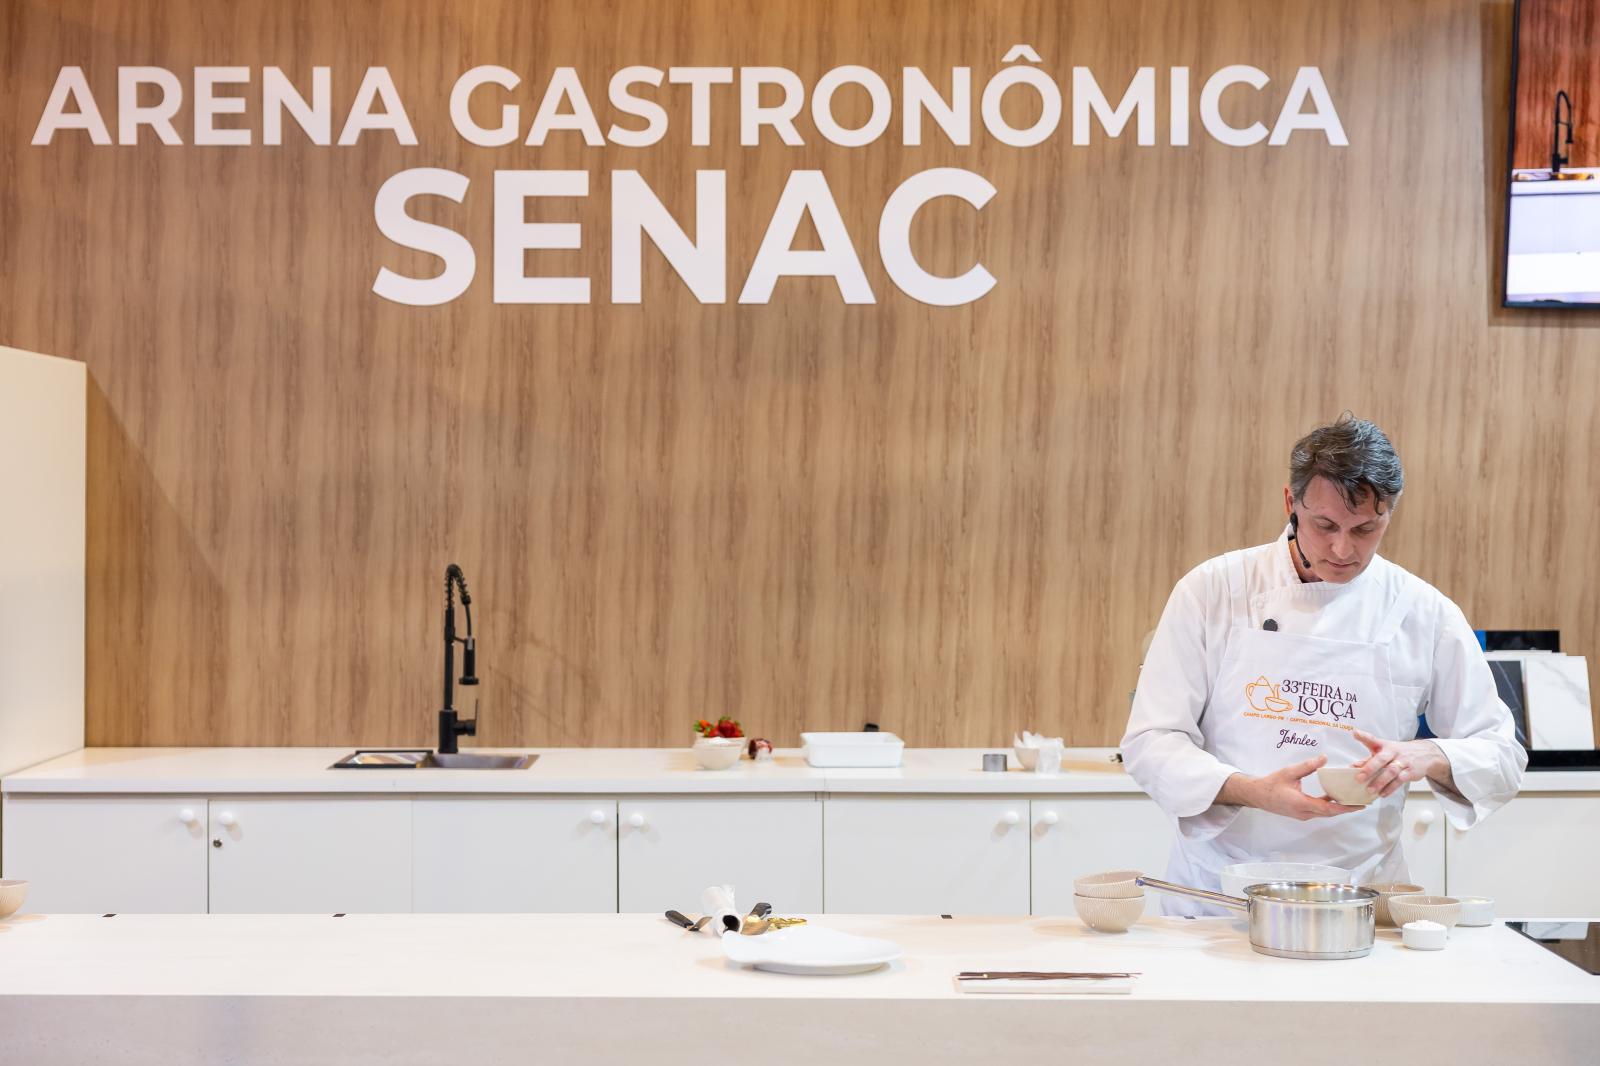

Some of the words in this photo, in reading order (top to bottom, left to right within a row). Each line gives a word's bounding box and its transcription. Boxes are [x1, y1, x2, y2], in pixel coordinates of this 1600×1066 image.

[32, 66, 418, 147] ARENA
[450, 44, 1349, 148] GASTRONÔMICA
[372, 167, 998, 306] SENAC
[1302, 681, 1343, 700] FEIRA
[1345, 692, 1358, 703] DA
[1297, 695, 1356, 721] LOUÇA
[1276, 728, 1318, 749] Johnlee
